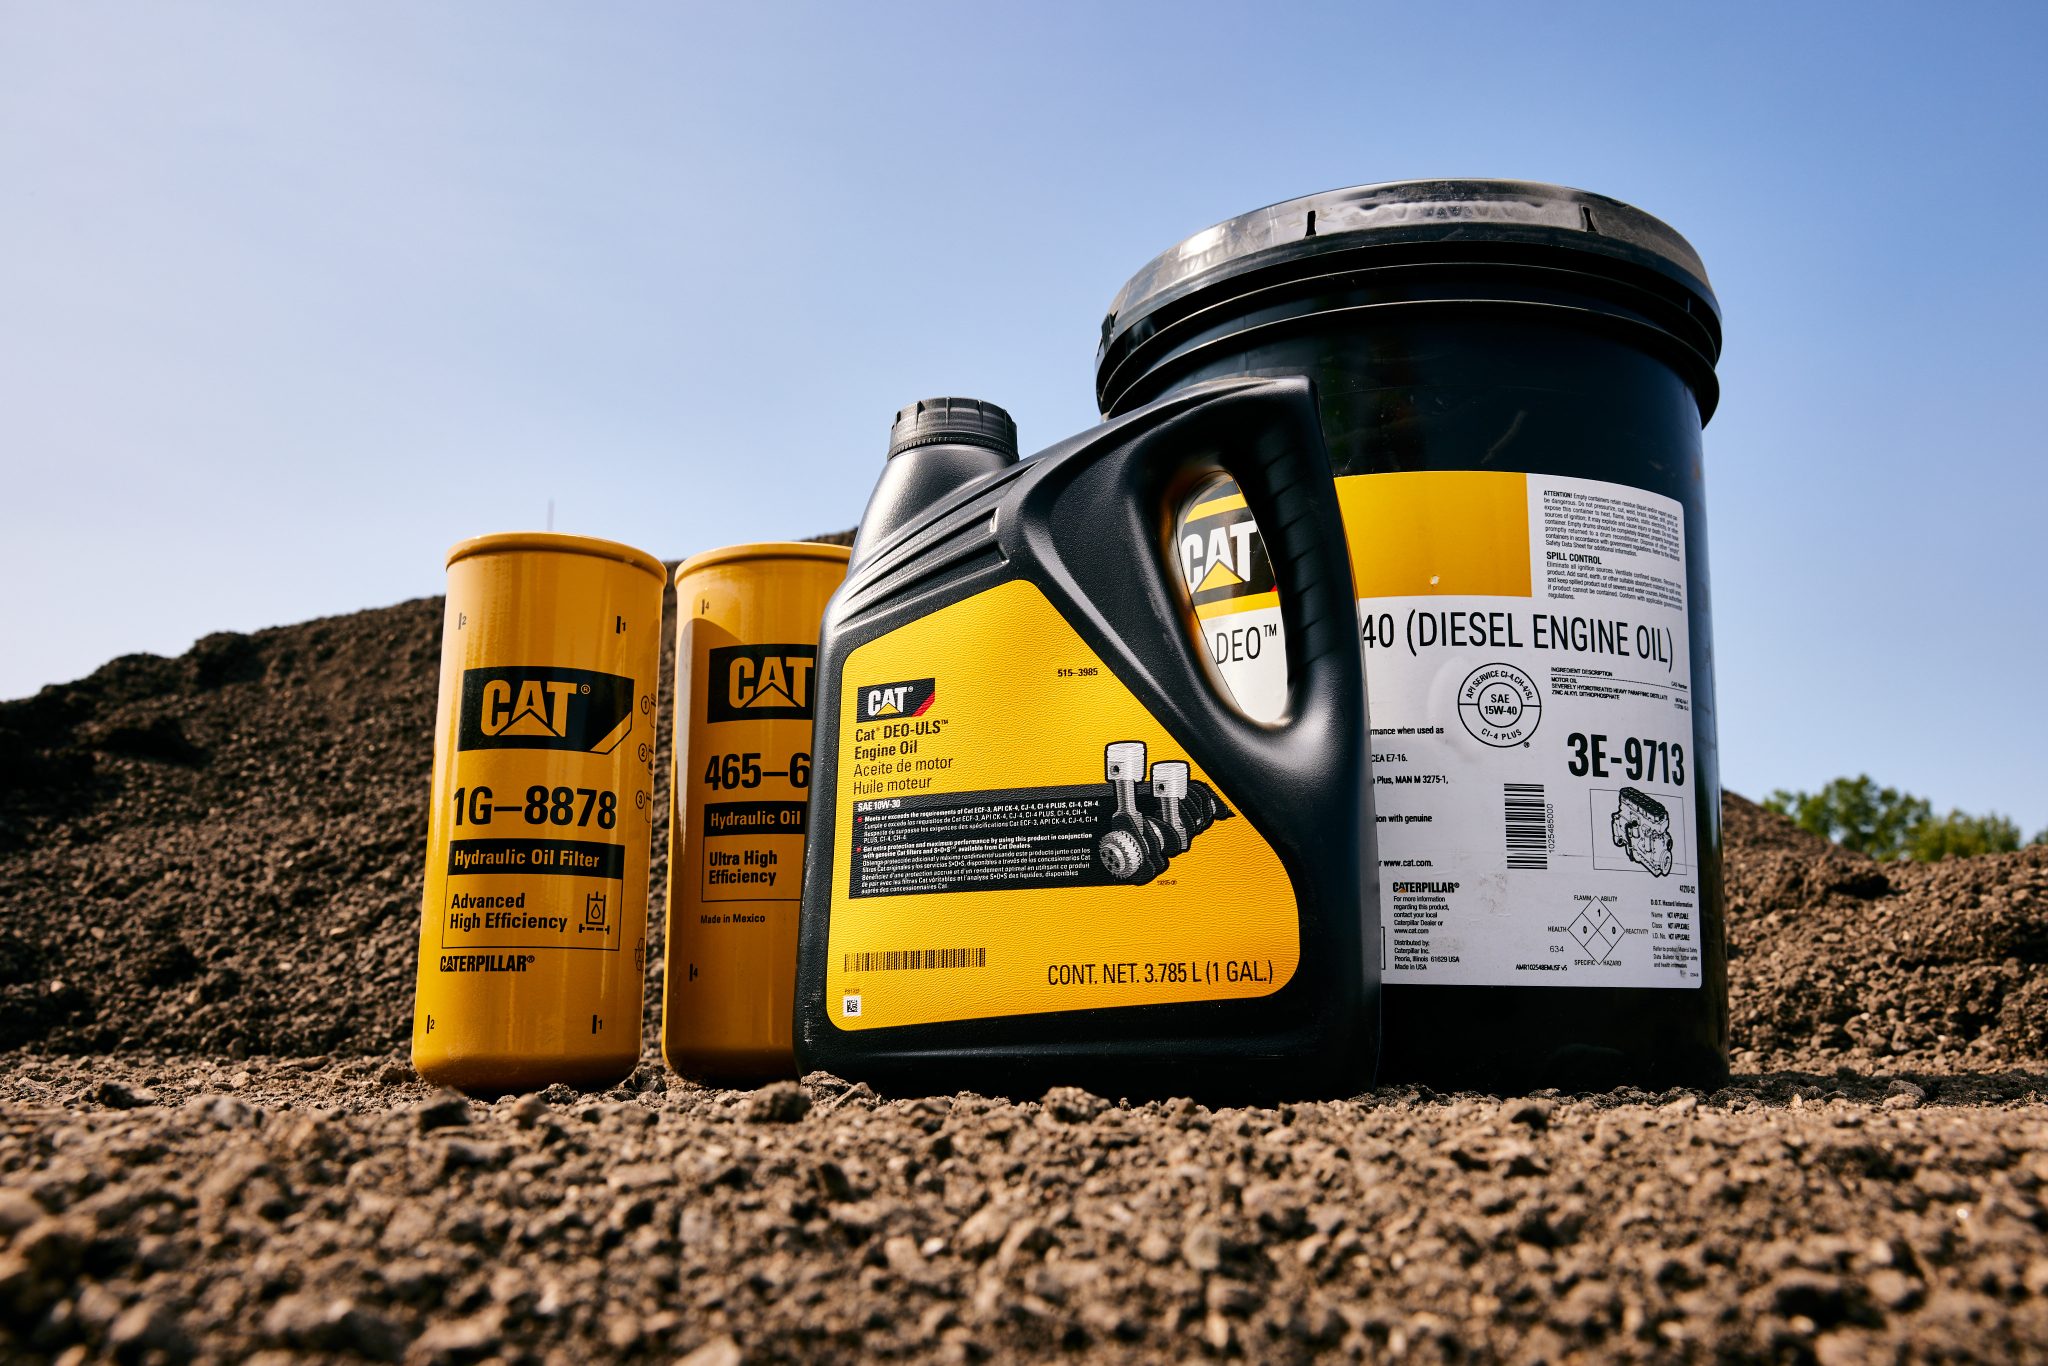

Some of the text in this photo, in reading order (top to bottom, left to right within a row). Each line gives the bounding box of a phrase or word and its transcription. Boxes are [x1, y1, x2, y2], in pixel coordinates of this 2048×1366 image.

[1543, 490, 1573, 499] ATTENTION!
[1181, 520, 1258, 594] CAT
[1546, 551, 1602, 565] SPILL CONTROL
[1407, 609, 1523, 657] (DIESEL
[1533, 613, 1630, 657] ENGINE
[1636, 625, 1673, 673] OIL)
[1472, 670, 1500, 688] SERVICE
[1582, 669, 1613, 677] DESCRIPTION
[728, 656, 814, 709] CAT
[1491, 694, 1510, 703] SAE
[1484, 706, 1517, 715] 15W-40
[1397, 726, 1415, 735] when
[1417, 726, 1434, 735] used
[1481, 728, 1522, 740] CI-4 PLUS
[855, 739, 918, 761] Engine Oil
[1386, 754, 1408, 763] E7-16.
[1567, 732, 1685, 787] 3E-9713
[853, 757, 954, 777] Aceite de motor
[853, 776, 932, 795] Huile moteur
[1377, 776, 1394, 785] Plus,
[1395, 776, 1413, 784] MAN
[1414, 776, 1421, 784] M
[1422, 775, 1449, 785] 3275-1,
[858, 799, 901, 812] SAE 10W-30
[1004, 804, 1020, 812] CK-4,
[1050, 801, 1068, 809] PLUS,
[711, 810, 800, 829] Hydraulic Oil
[1388, 814, 1403, 823] with
[1404, 814, 1433, 824] genuine
[454, 849, 600, 868] Hydraulic Oil Filter
[709, 850, 778, 868] Ultra High
[709, 870, 777, 886] Efficiency
[451, 892, 526, 909] Advanced
[450, 912, 568, 933] High Efficiency
[700, 914, 766, 924] Made in Mexico
[1394, 919, 1420, 927] Caterpillar
[1421, 939, 1430, 947] by:
[1549, 945, 1564, 953] 634
[1394, 947, 1419, 955] Caterpillar
[1048, 960, 1273, 986] CONT. NET. 3.785 L (1 GAL.)
